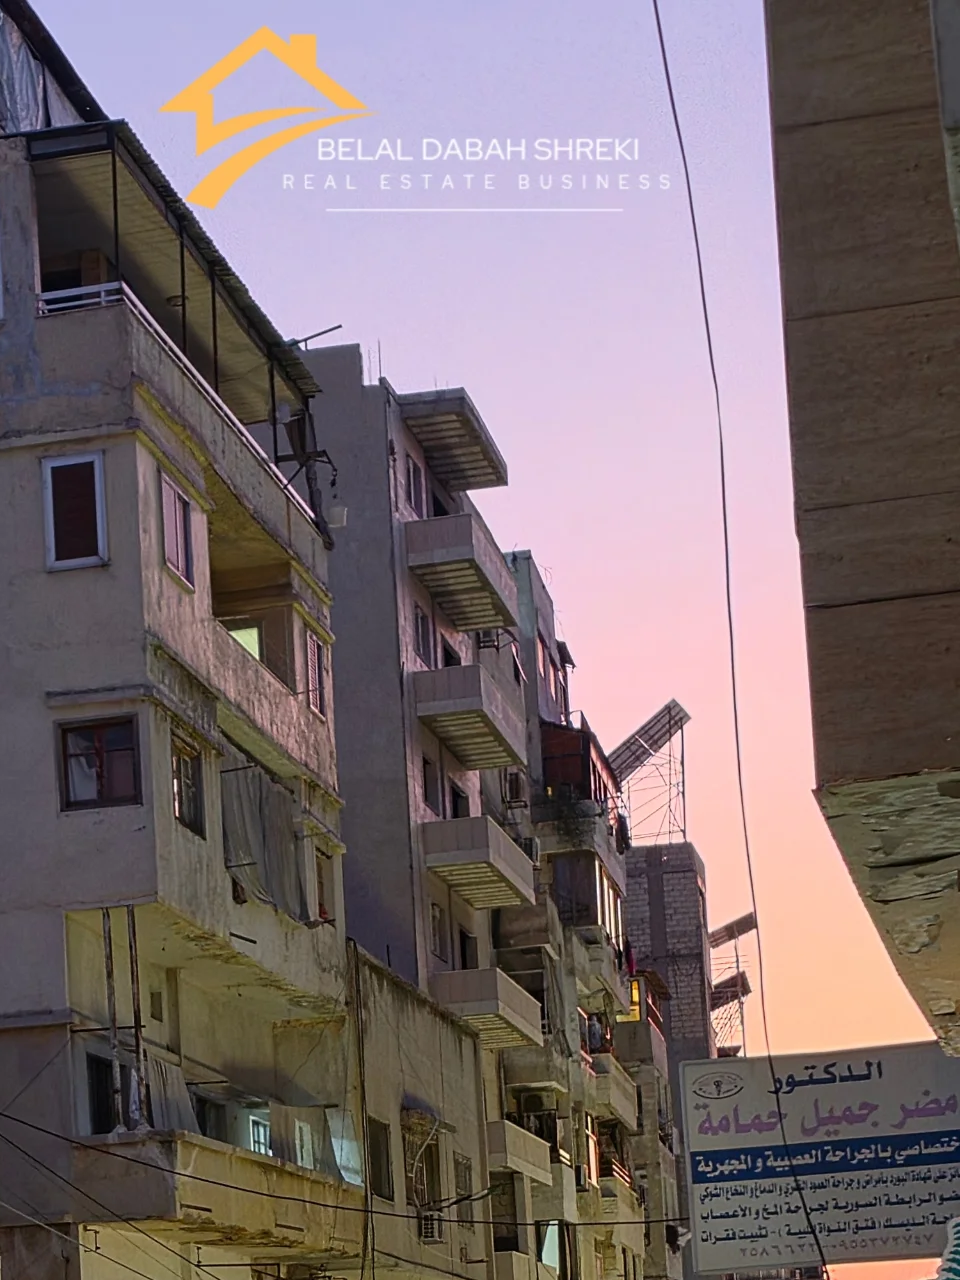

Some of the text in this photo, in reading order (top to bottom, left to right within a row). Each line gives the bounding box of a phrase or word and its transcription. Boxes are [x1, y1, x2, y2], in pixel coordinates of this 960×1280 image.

[767, 1060, 883, 1095] الدكتور
[693, 1103, 788, 1137] حمامة
[800, 1098, 880, 1138] جميل
